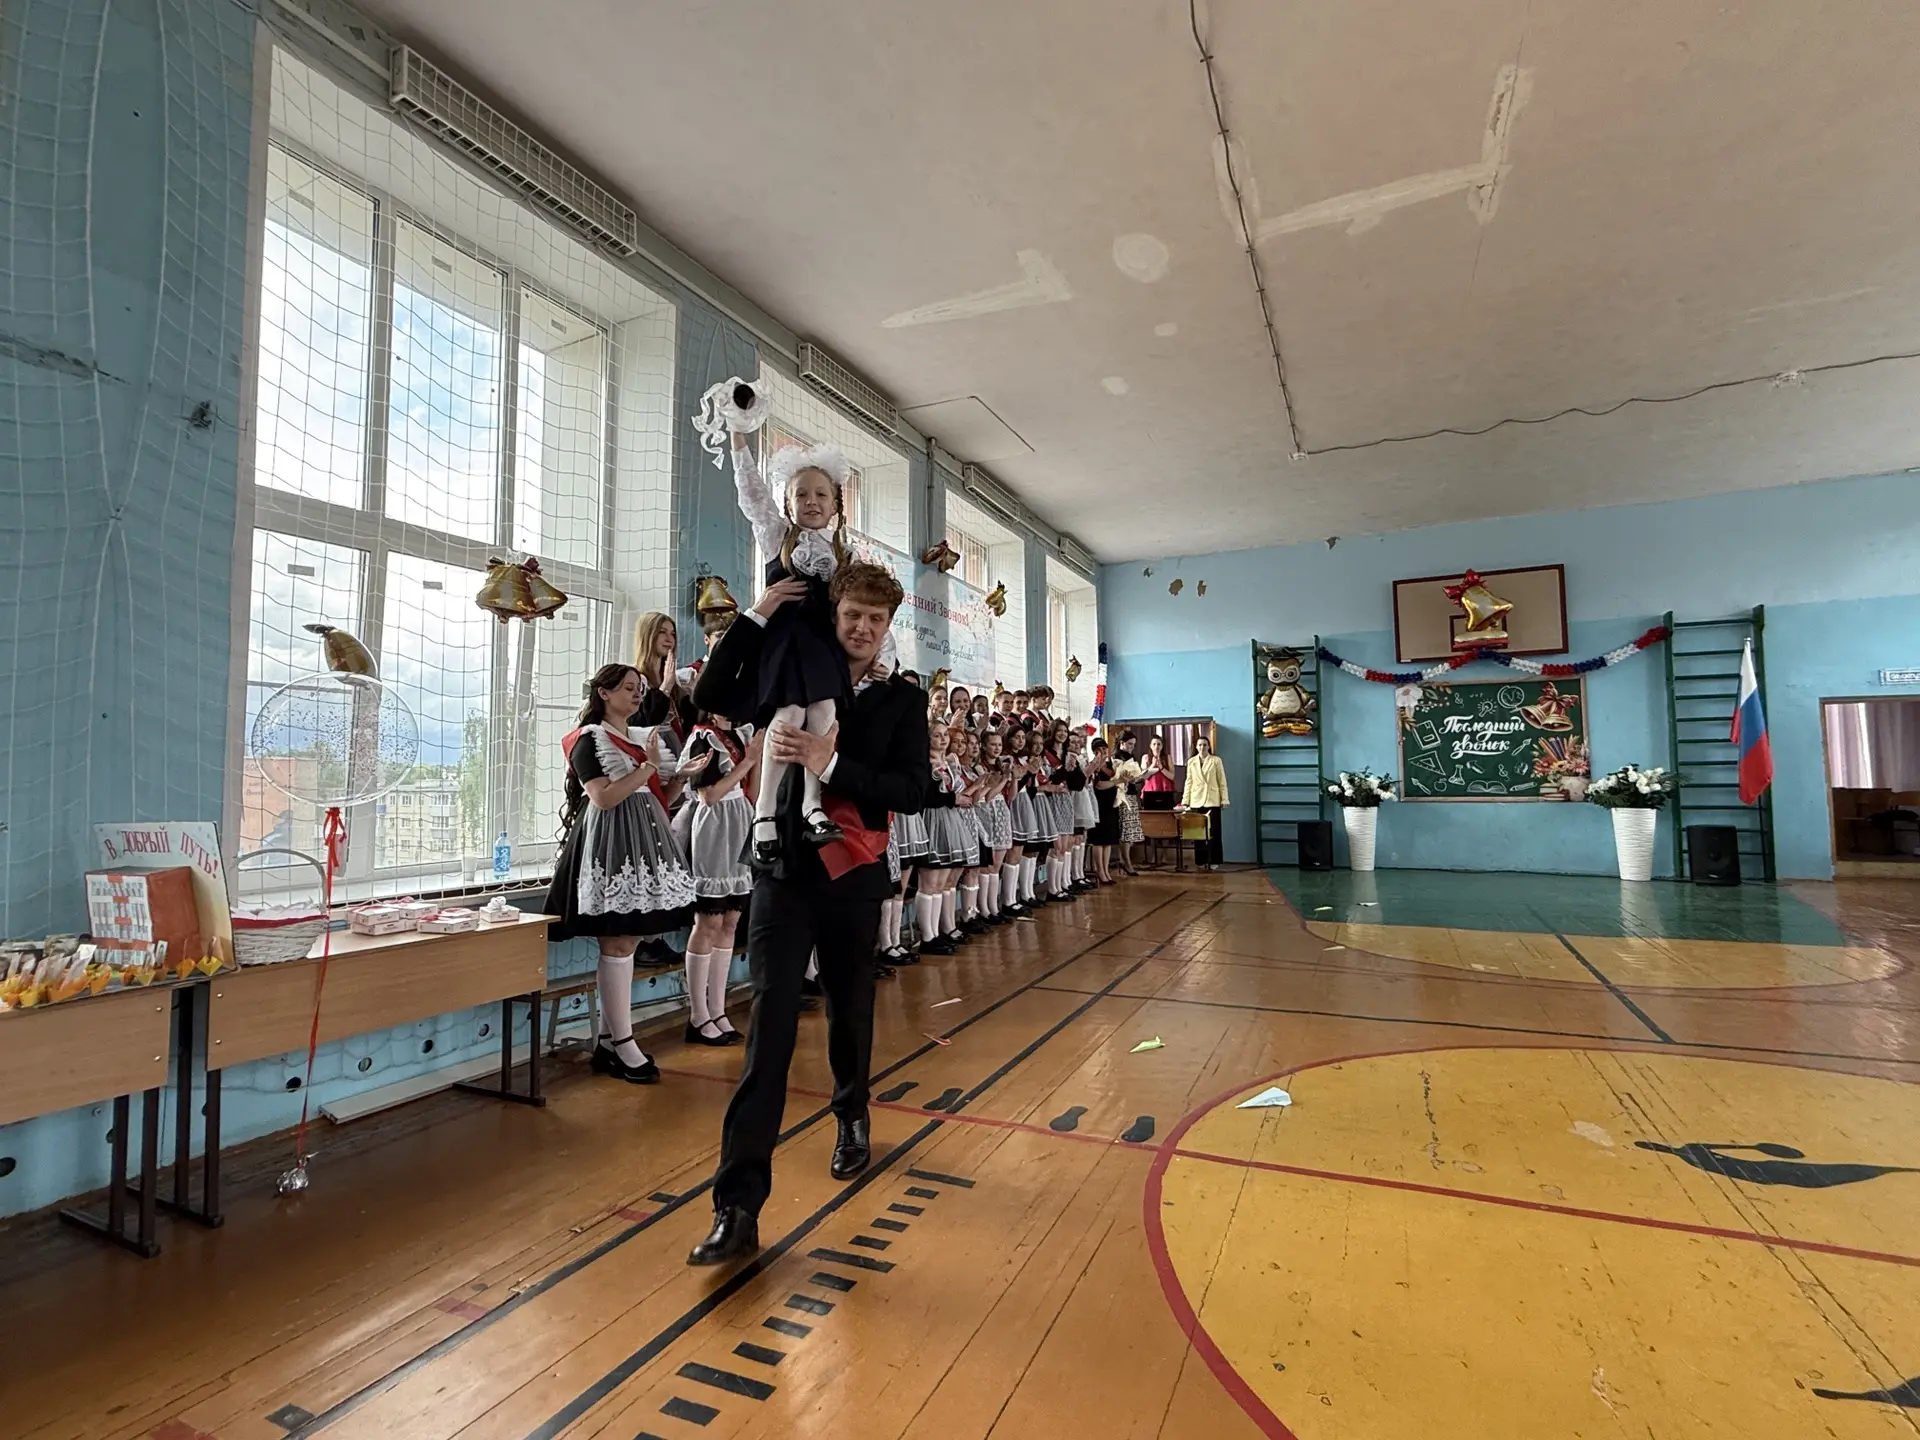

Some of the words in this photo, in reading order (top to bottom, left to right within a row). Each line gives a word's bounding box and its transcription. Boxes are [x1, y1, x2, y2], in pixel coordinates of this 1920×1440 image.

[938, 601, 969, 627] Звонок!
[1438, 714, 1526, 742] Последний
[1450, 734, 1510, 760] звонок
[104, 838, 118, 860] В
[121, 826, 171, 856] ДОБРЫЙ
[180, 832, 218, 879] ПУТЬ!
